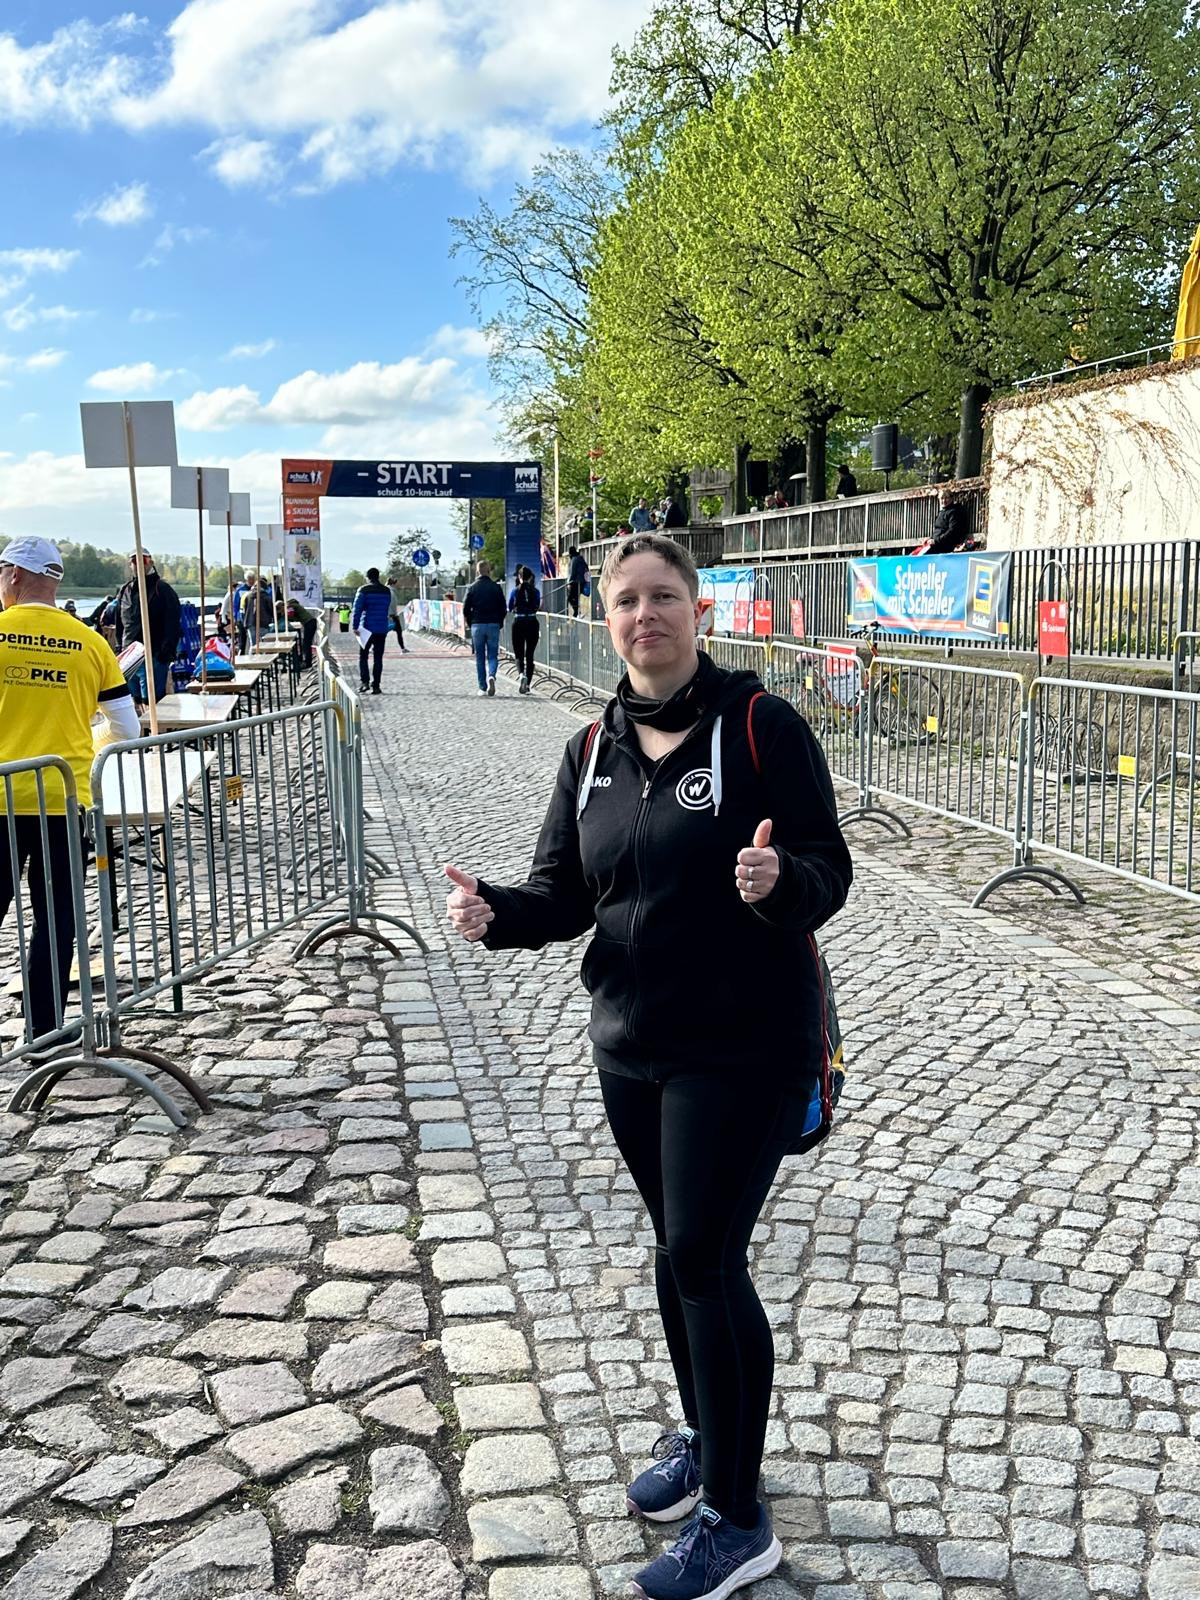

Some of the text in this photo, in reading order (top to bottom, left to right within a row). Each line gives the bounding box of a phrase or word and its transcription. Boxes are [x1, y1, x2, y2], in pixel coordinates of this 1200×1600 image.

[376, 463, 453, 485] START
[377, 488, 453, 497] schulz 10-km-Lauf
[515, 481, 539, 489] schulz
[895, 563, 948, 591] Schneller
[887, 591, 906, 614] mit
[908, 589, 954, 616] Scheller
[31, 668, 67, 683] PKE
